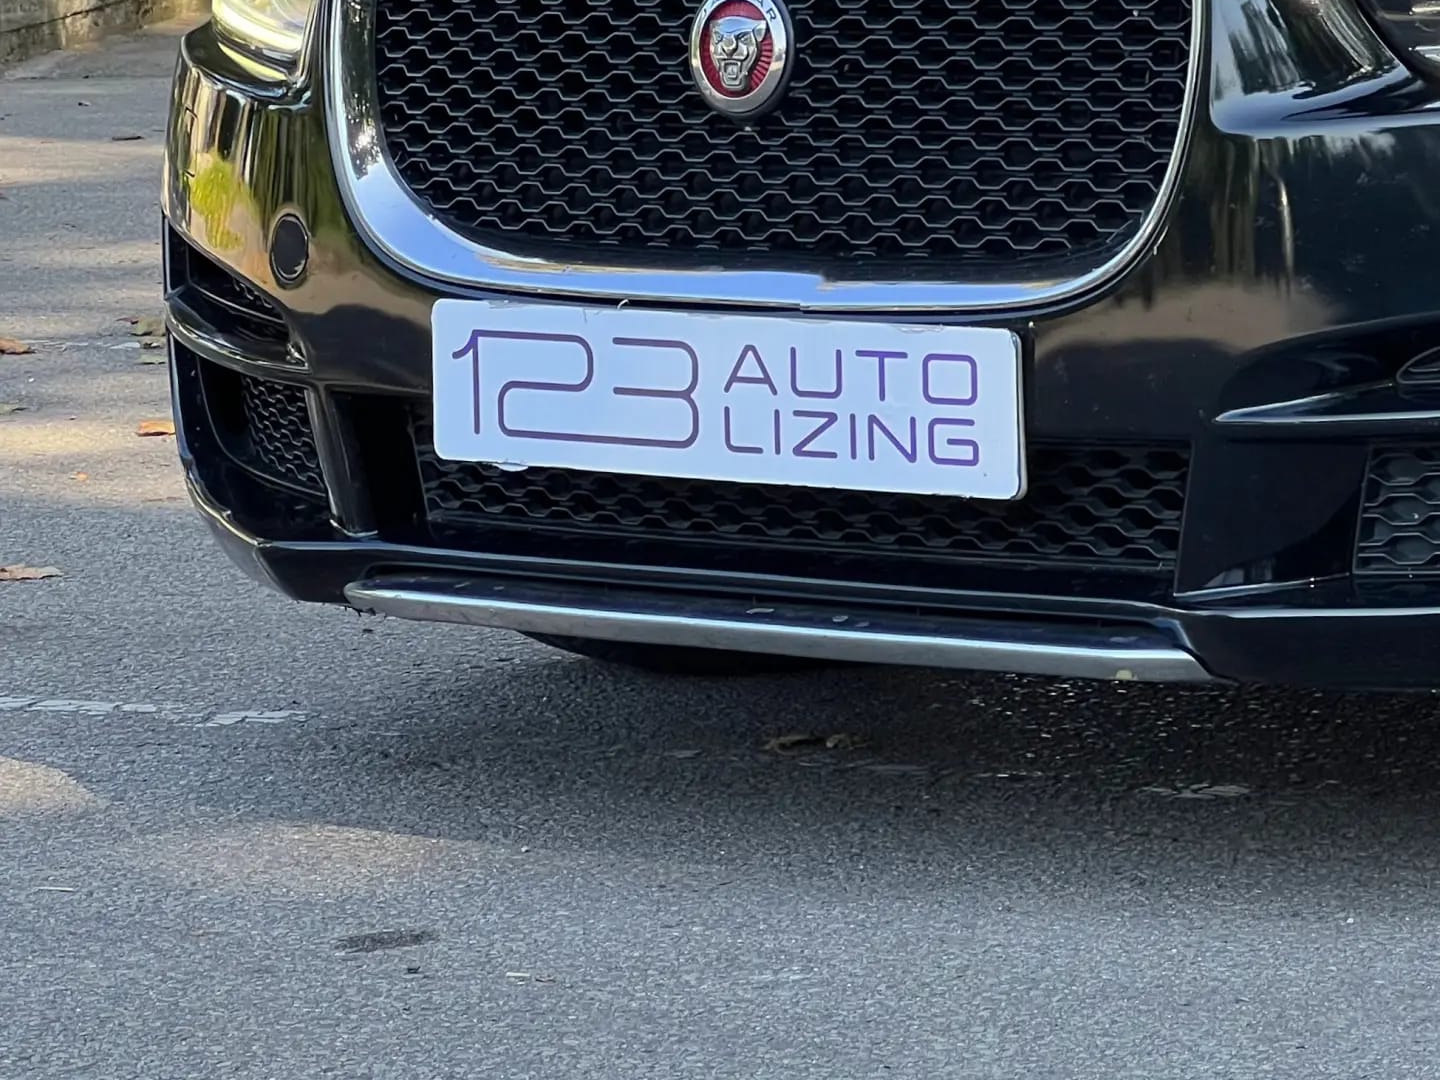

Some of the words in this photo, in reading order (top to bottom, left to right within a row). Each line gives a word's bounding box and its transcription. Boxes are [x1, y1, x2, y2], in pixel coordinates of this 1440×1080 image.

[452, 329, 699, 449] 123
[724, 344, 978, 406] AUTO
[724, 406, 980, 467] LIZING
